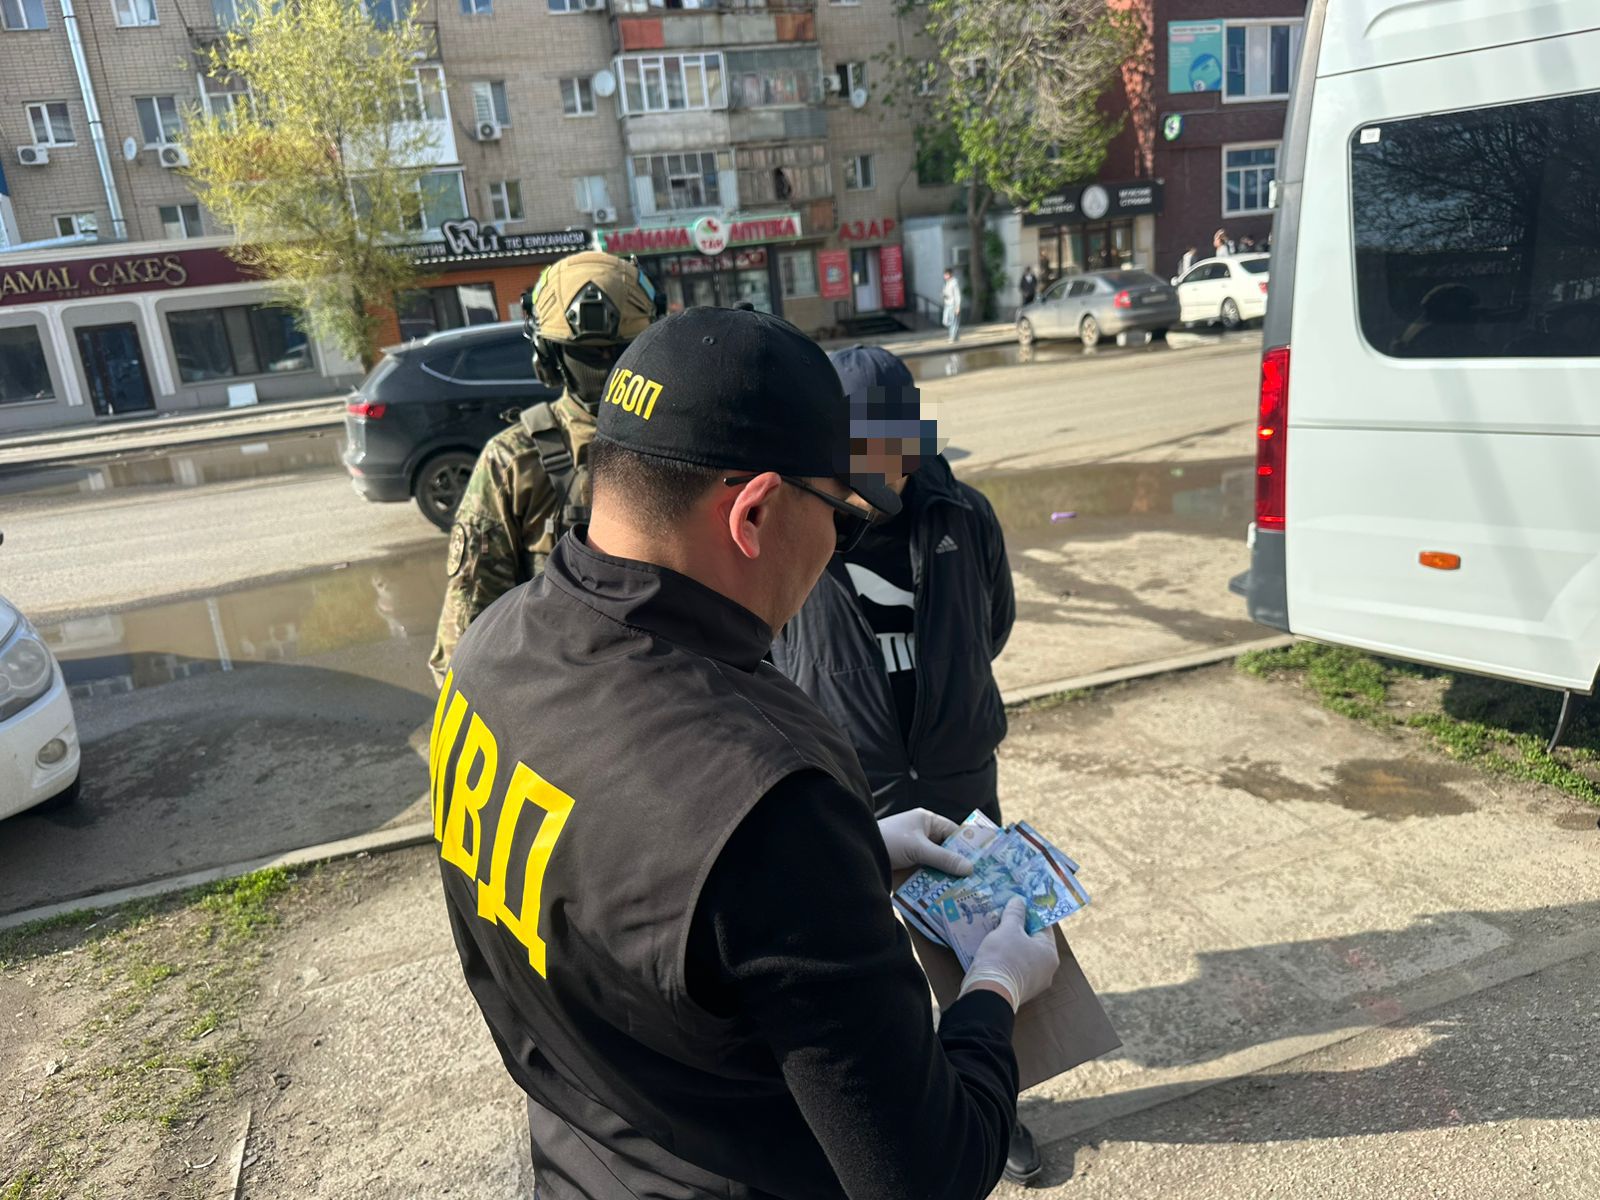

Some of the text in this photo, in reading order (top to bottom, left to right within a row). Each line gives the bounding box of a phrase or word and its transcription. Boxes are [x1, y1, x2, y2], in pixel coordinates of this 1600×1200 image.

[730, 217, 796, 242] АПТЕКА
[838, 216, 896, 242] АЗАР
[0, 255, 188, 300] AMAL CAKES
[604, 367, 664, 421] УБОП
